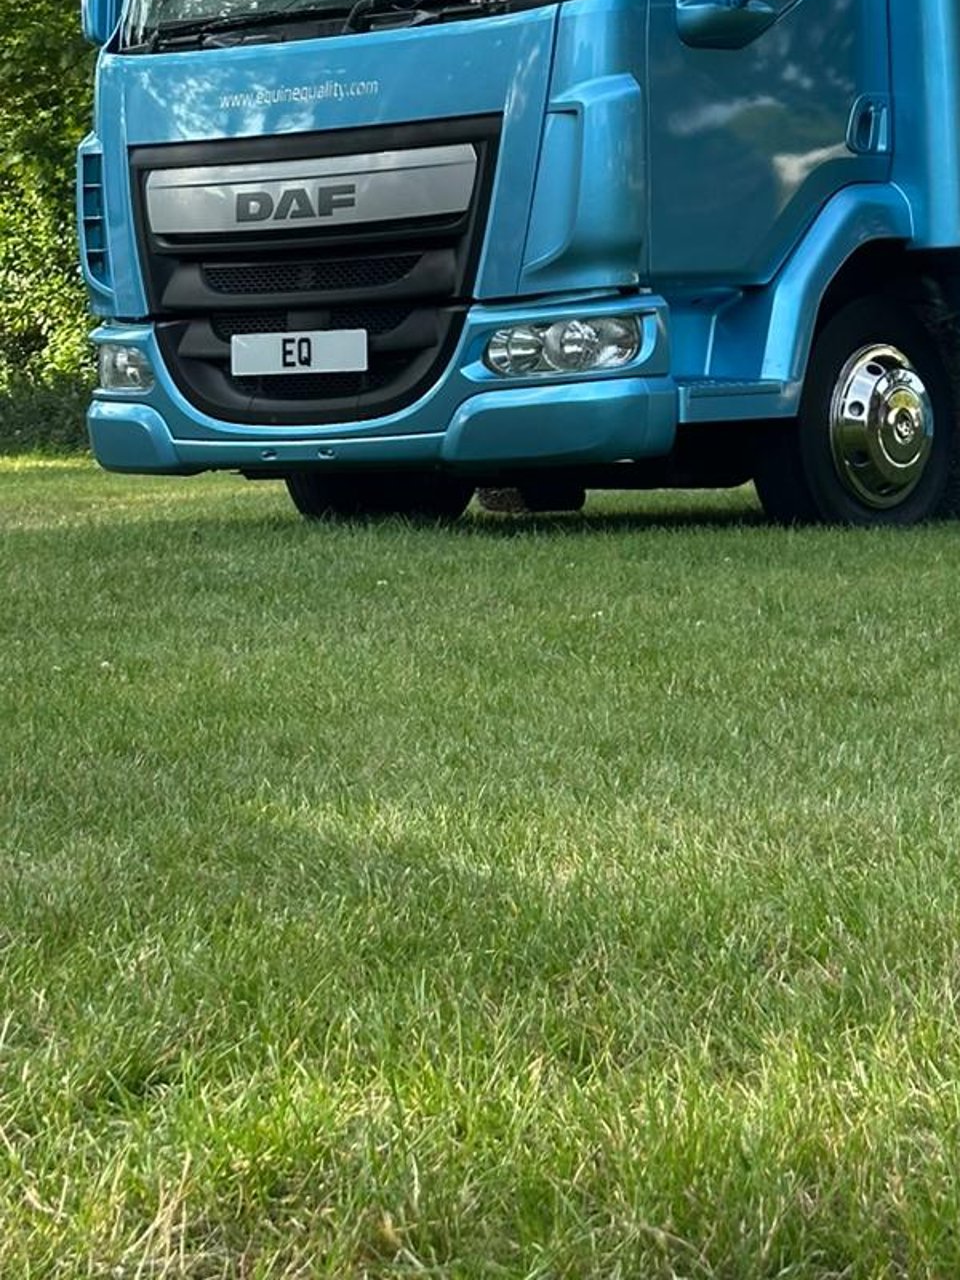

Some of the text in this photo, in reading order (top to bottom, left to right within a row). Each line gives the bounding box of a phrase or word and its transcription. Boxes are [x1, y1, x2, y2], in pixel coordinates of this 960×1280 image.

[219, 80, 379, 108] www.equinequality.com
[236, 184, 356, 223] DAF
[282, 337, 312, 367] EQ
